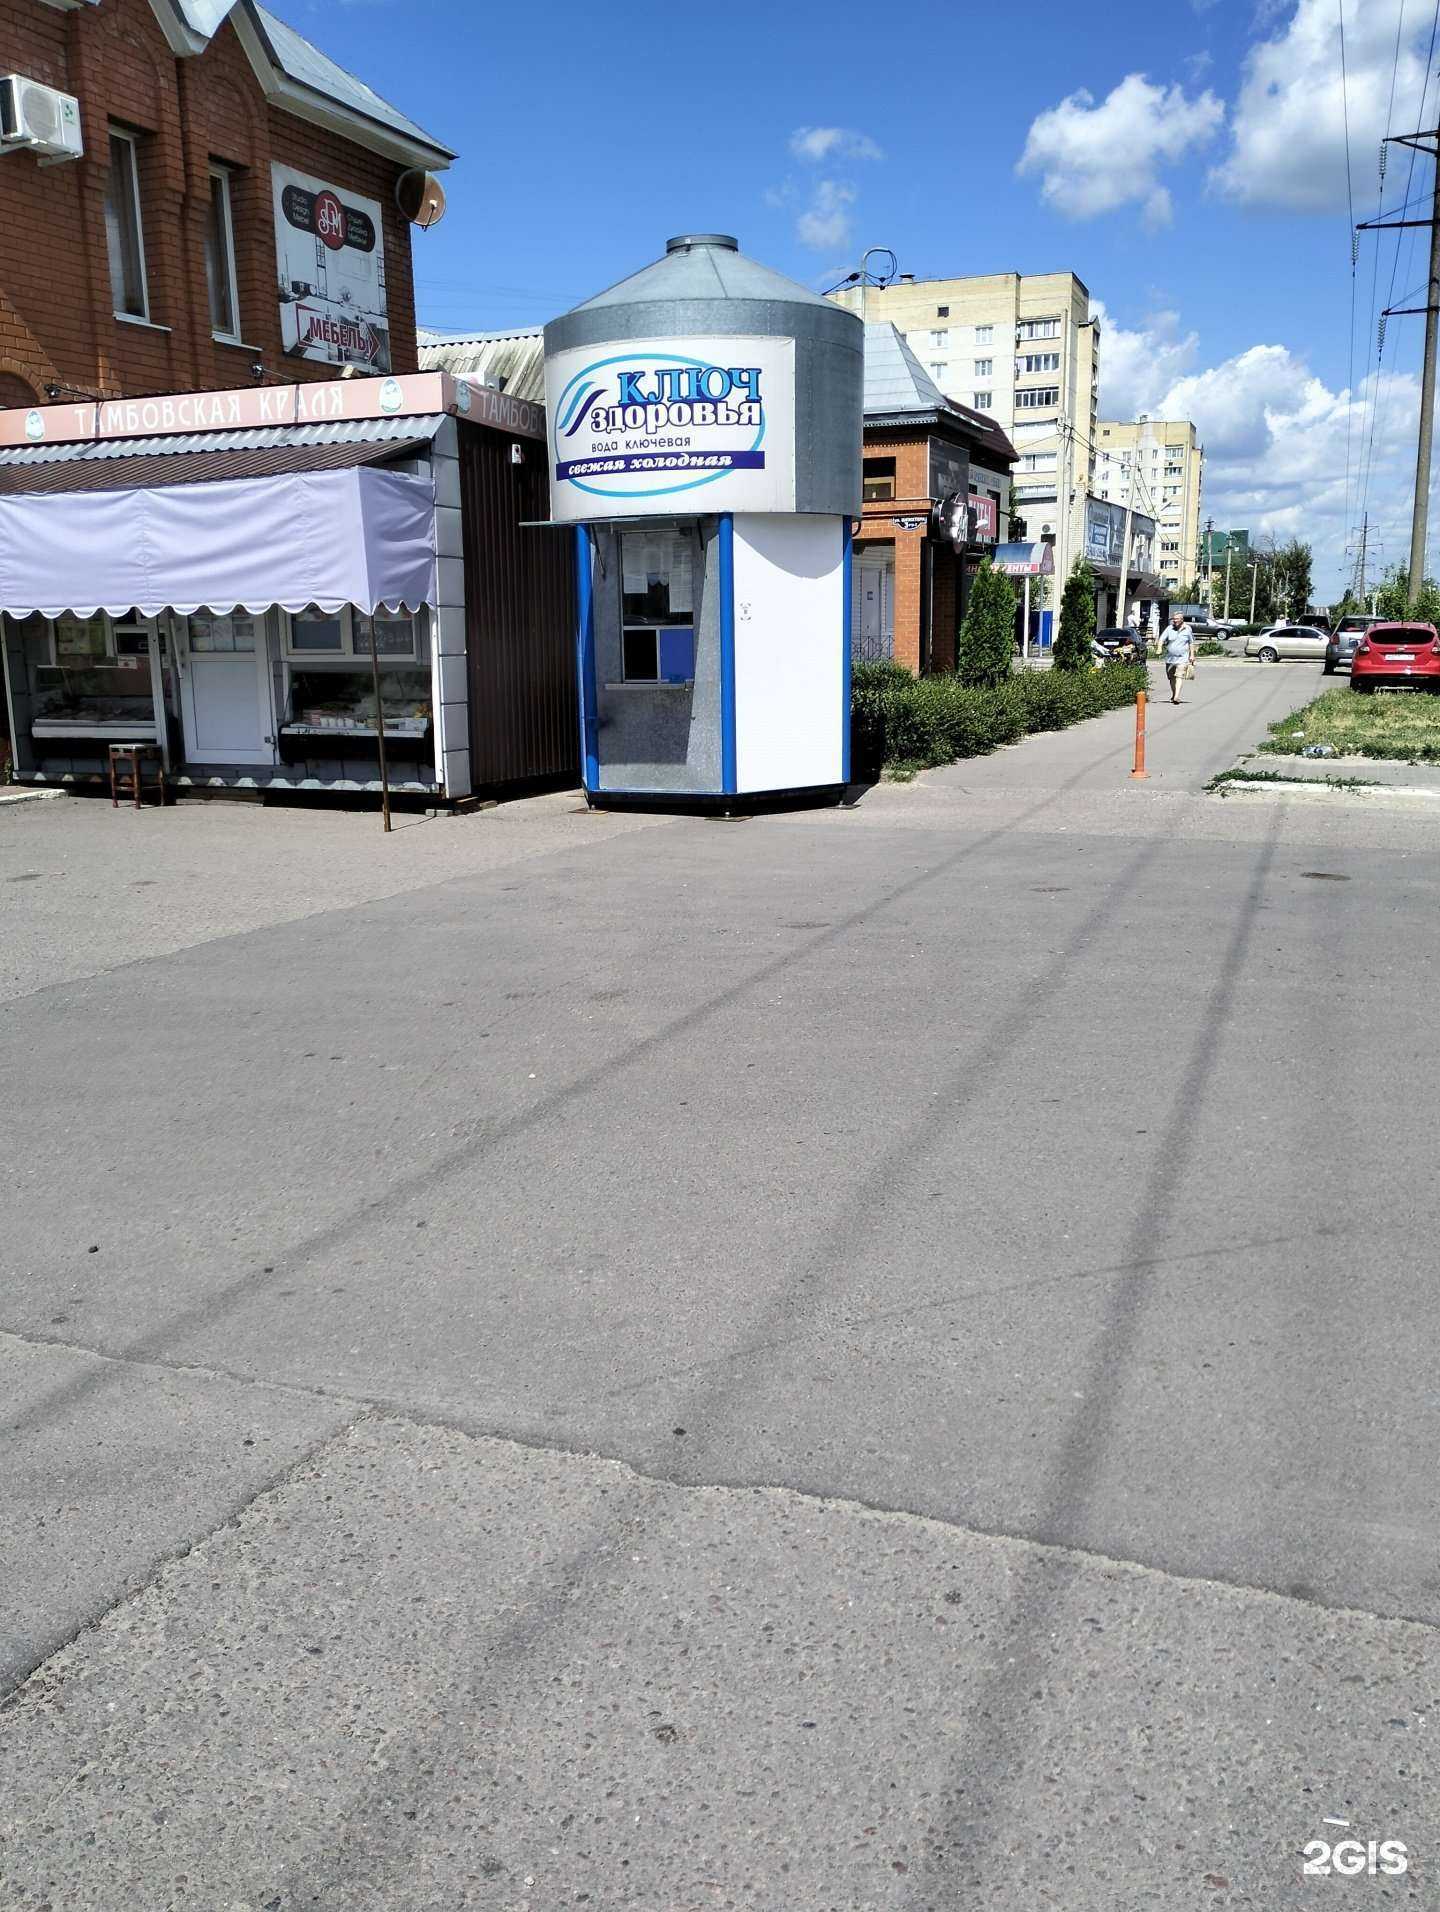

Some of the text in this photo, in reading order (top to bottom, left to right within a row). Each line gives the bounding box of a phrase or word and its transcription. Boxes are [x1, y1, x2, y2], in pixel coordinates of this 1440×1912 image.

[309, 316, 368, 351] МЕБЕЛЬ
[617, 367, 763, 405] КЛЮЧ
[75, 385, 343, 435] ТАМБОВСКАЯ КРАЛЯ
[591, 436, 692, 452] вода ключевая
[568, 453, 733, 475] свежая холодная
